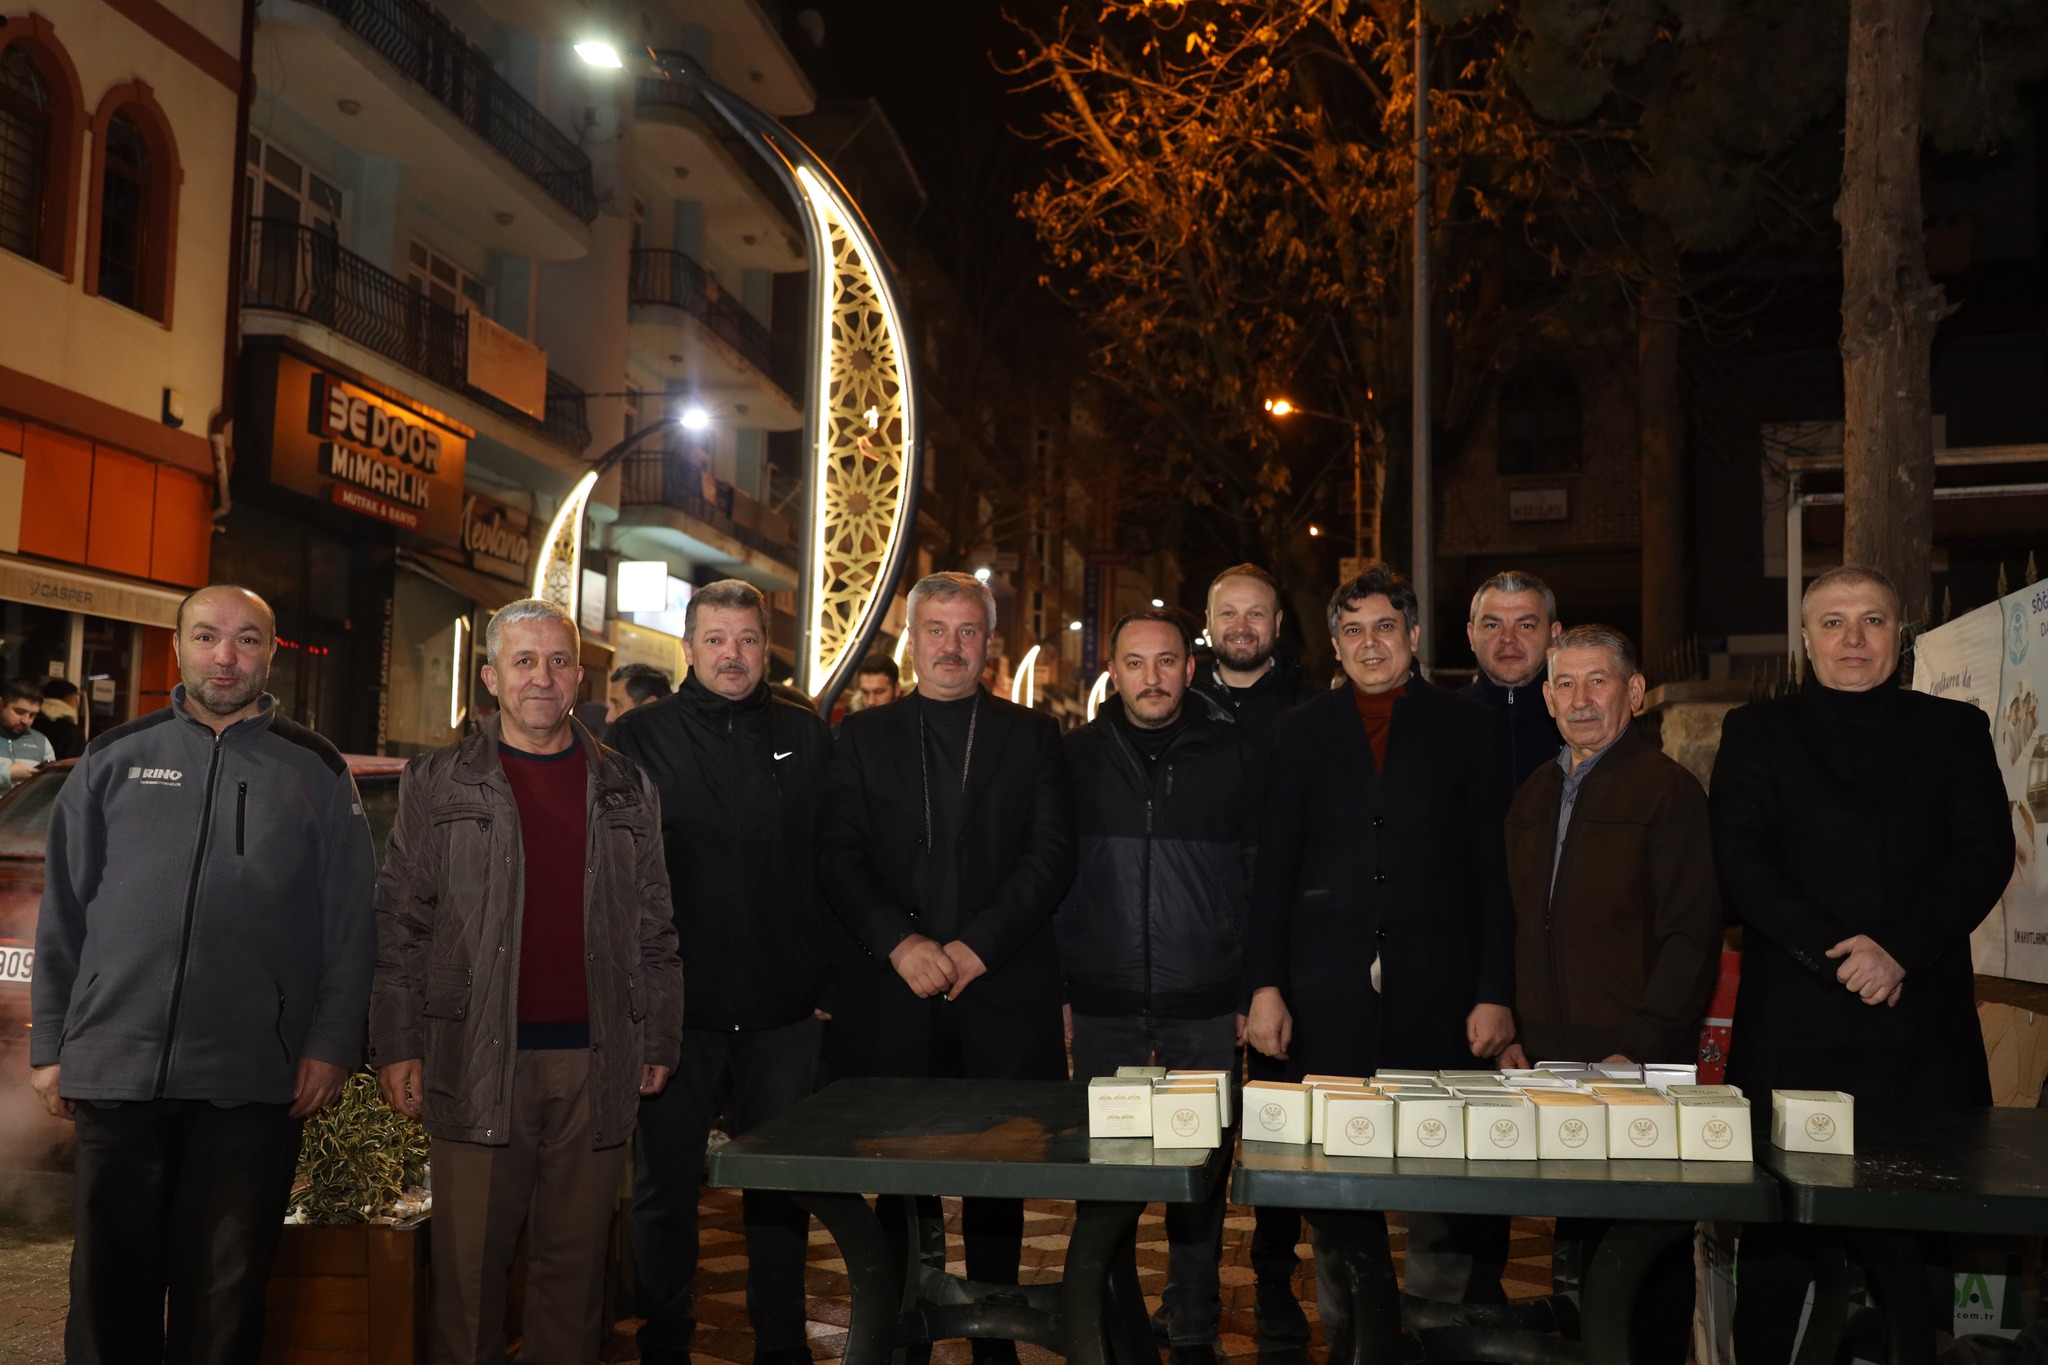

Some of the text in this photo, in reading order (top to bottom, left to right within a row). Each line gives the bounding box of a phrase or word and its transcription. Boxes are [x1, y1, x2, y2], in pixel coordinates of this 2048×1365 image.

[371, 405, 442, 473] DOOR
[40, 584, 93, 604] CASPER
[142, 767, 183, 781] RINO
